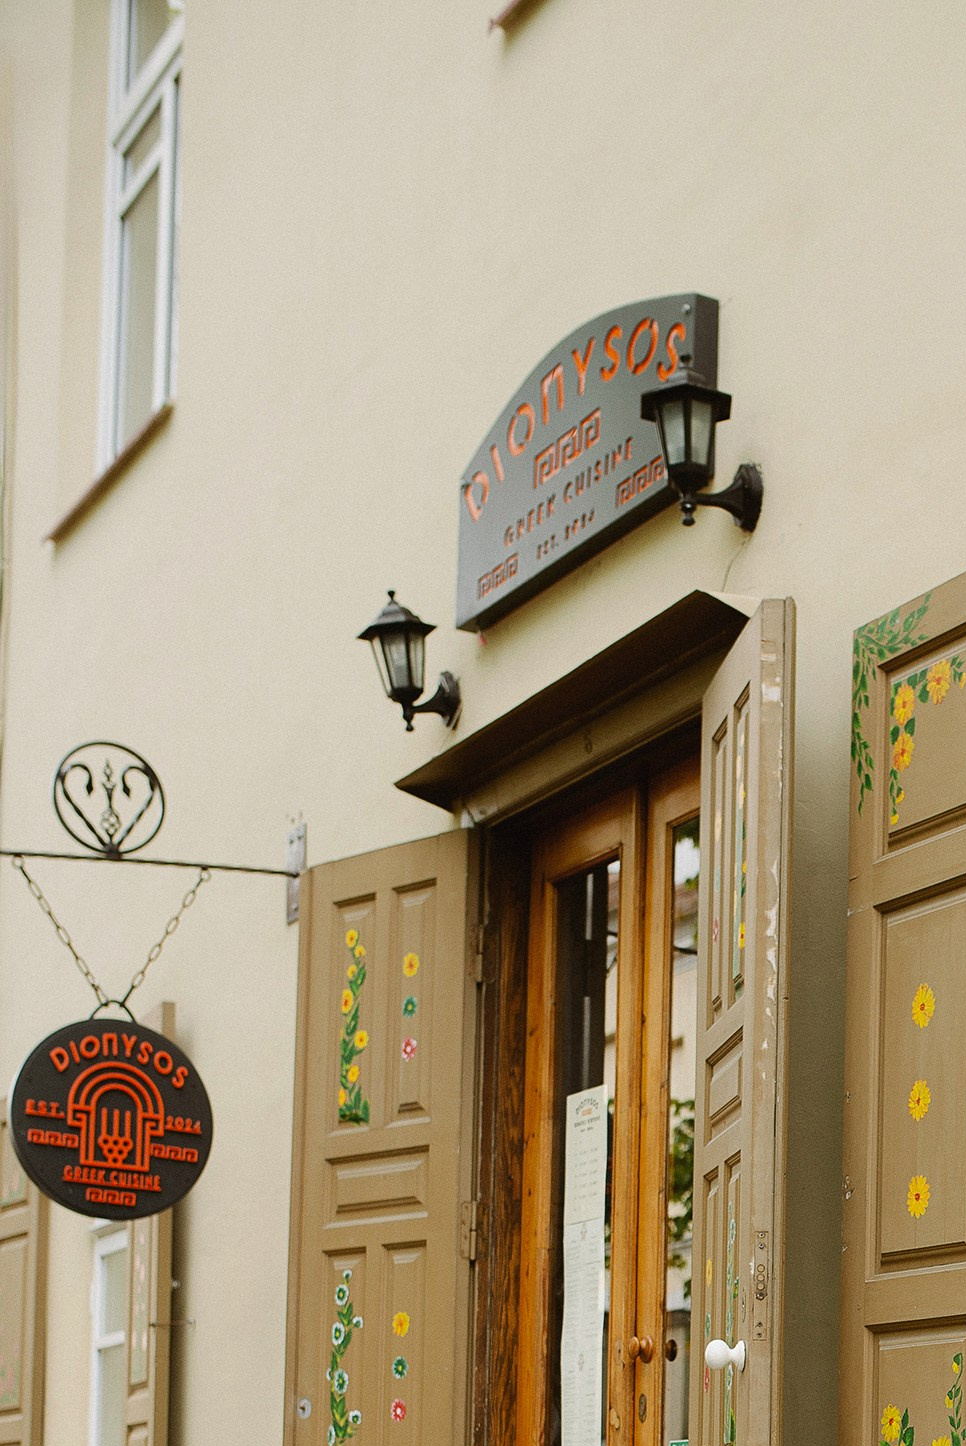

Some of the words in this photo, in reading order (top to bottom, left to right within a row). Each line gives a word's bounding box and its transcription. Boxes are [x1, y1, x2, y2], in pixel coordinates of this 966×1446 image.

[504, 494, 557, 547] GREEK
[563, 436, 634, 504] CUISINE
[25, 1098, 65, 1118] EST.
[62, 1165, 107, 1185] GREEK
[109, 1170, 162, 1192] CUISINE
